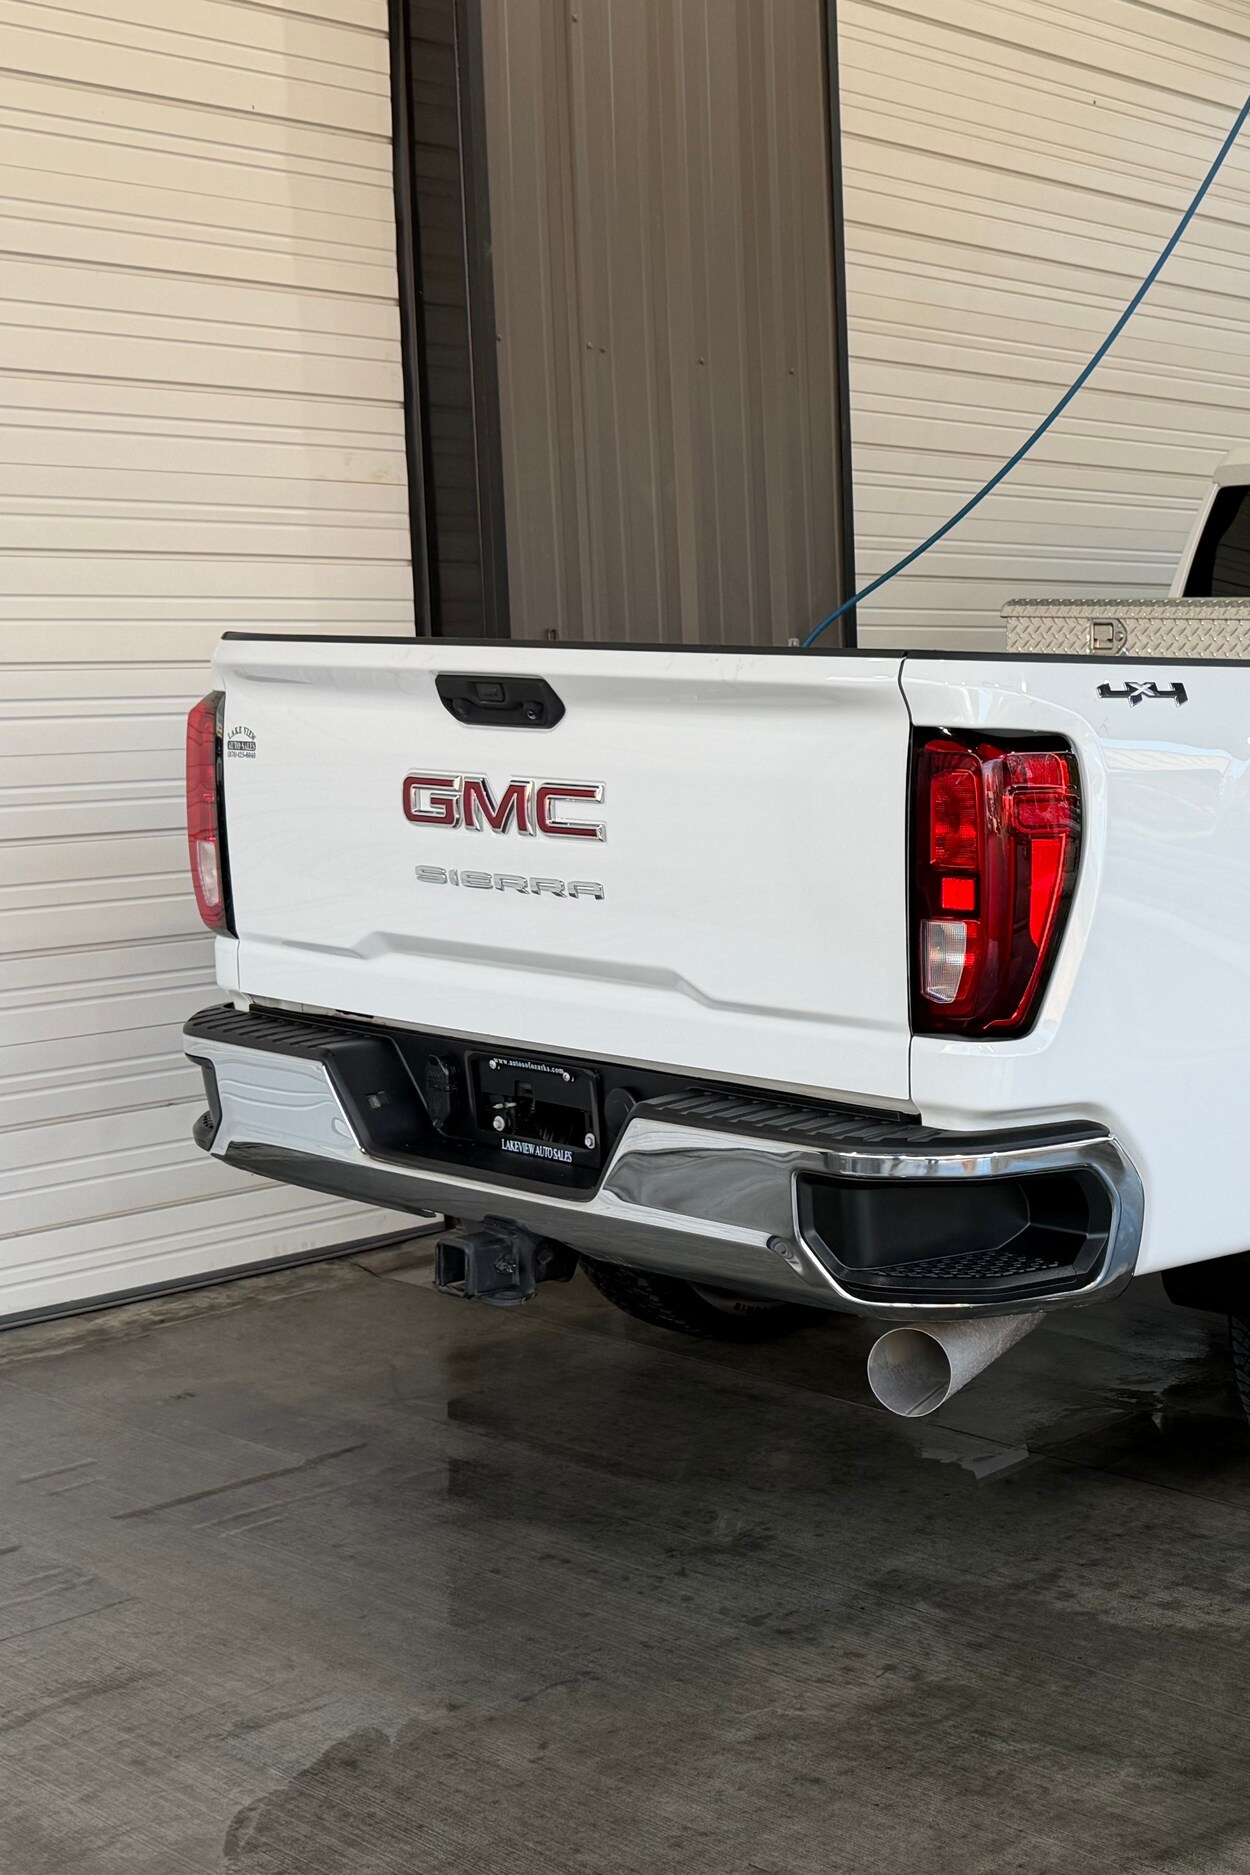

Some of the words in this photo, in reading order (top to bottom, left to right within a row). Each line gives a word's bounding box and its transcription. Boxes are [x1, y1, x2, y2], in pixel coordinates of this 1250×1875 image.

[227, 726, 242, 739] LAKE
[243, 726, 257, 741] VIEW
[228, 741, 241, 750] AUTO
[241, 742, 256, 750] SALES
[402, 770, 606, 842] GMC
[415, 864, 605, 900] SIERRA
[501, 1138, 535, 1155] LAKEVIEW
[535, 1143, 553, 1159] AUTO
[553, 1148, 573, 1162] SALES
